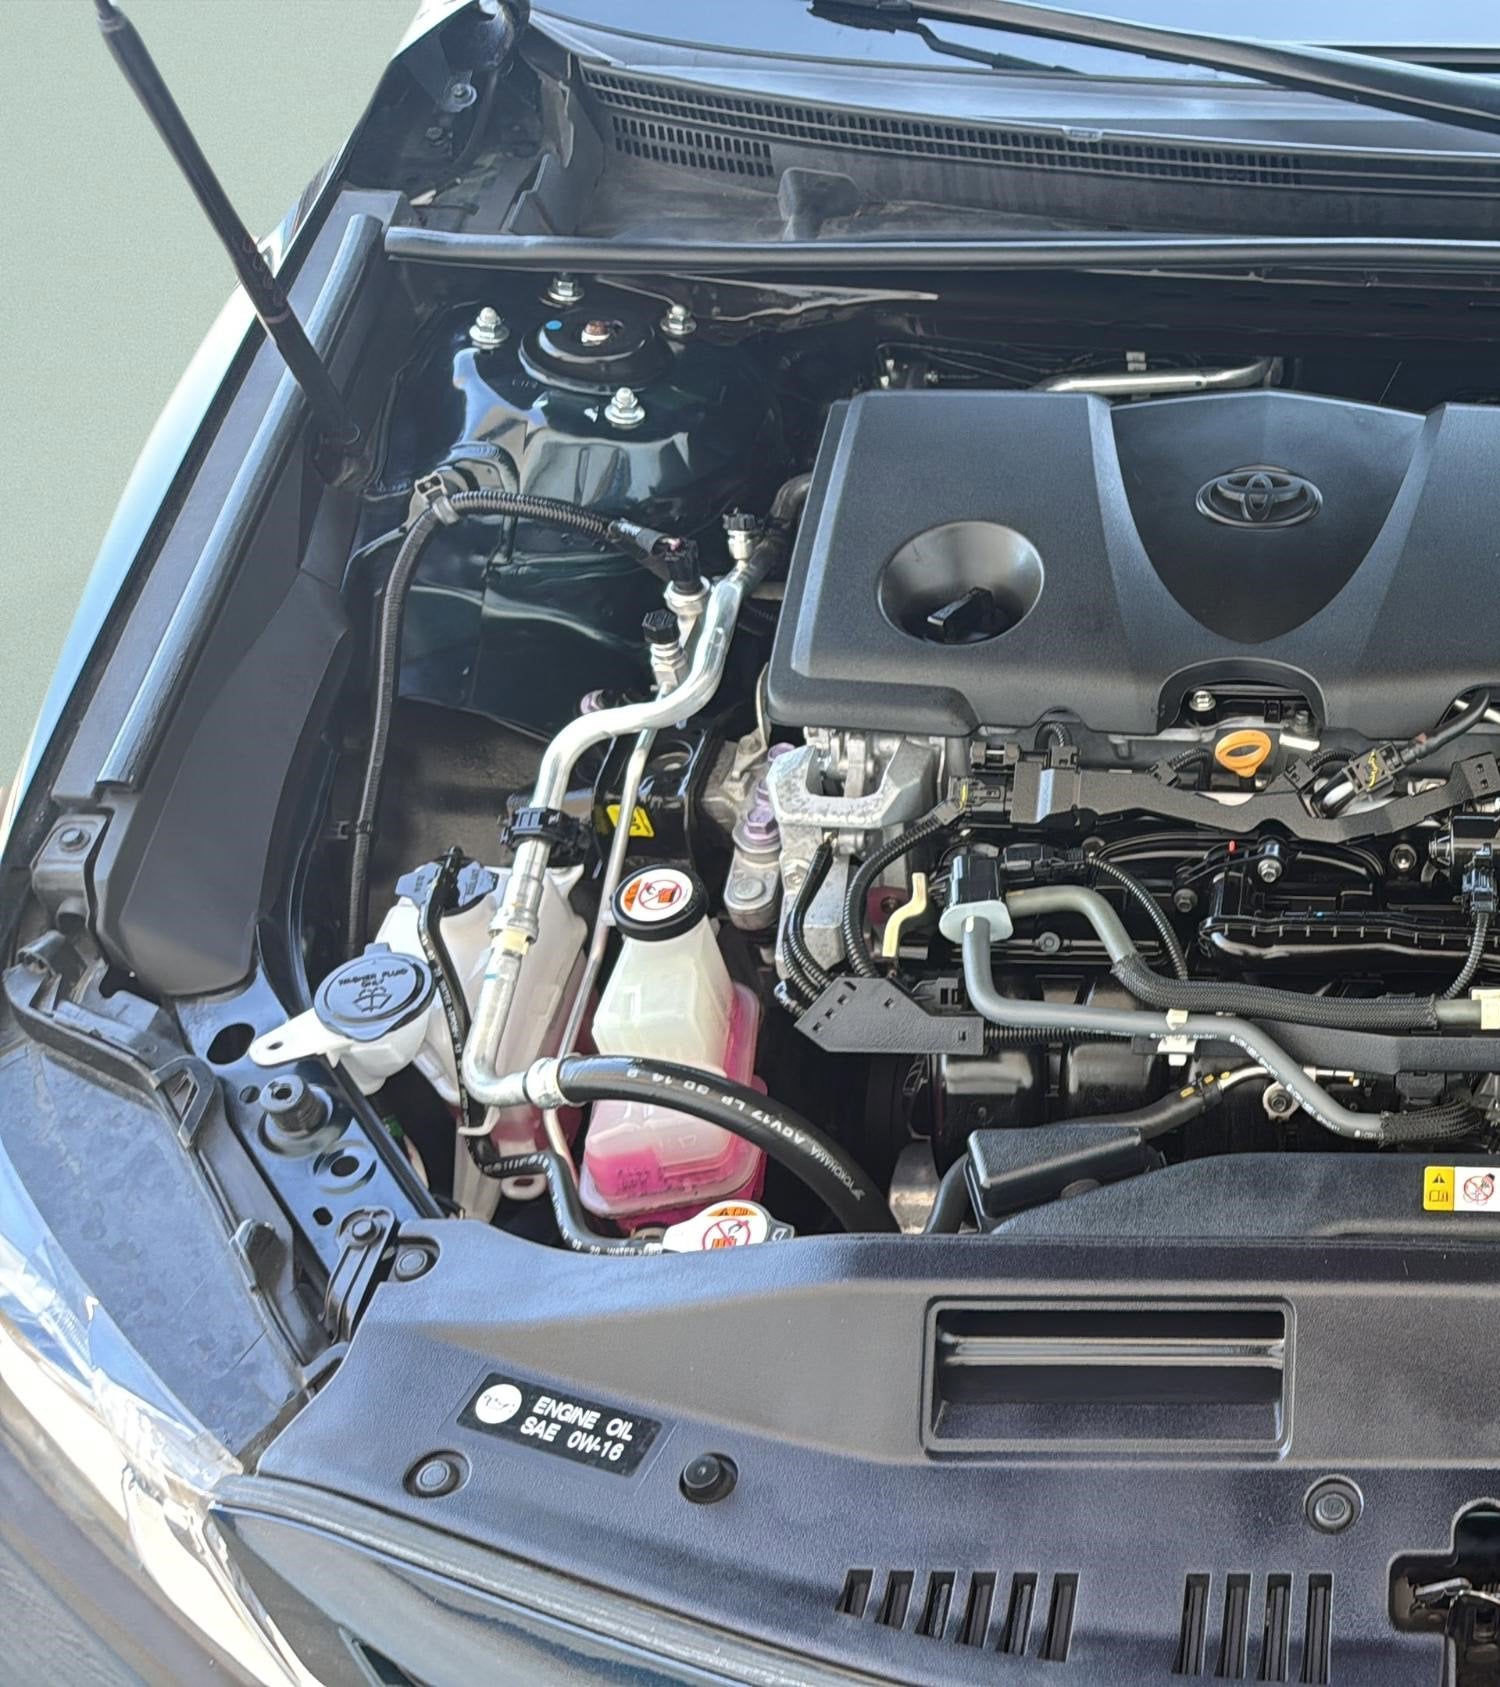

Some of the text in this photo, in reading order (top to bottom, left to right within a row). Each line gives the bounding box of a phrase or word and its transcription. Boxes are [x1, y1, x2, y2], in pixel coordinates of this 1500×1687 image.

[651, 1071, 674, 1087] 14
[810, 1144, 855, 1190] YOKOHAMA
[520, 1416, 625, 1462] SAE 0W-16
[533, 1396, 634, 1442] ENGINE OIL
